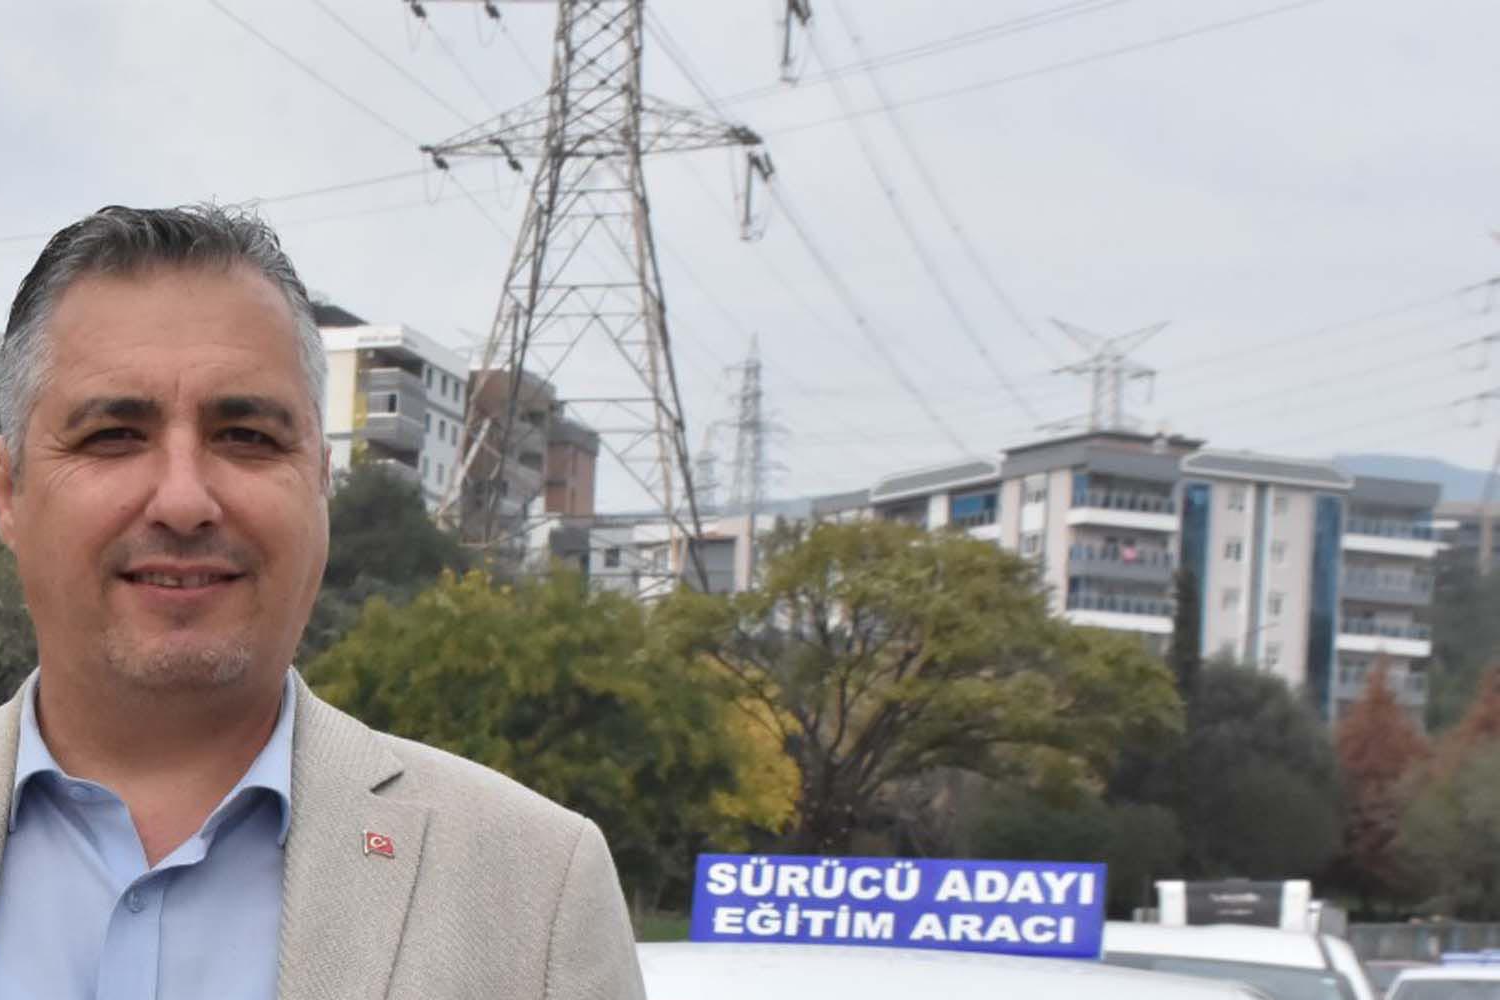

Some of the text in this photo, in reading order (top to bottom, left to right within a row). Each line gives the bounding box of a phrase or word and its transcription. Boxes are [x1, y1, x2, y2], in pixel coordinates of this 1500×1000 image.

[706, 857, 1096, 905] SÜRÜCÜ ADAYI
[713, 902, 1076, 943] EĞİTİM ARACI
